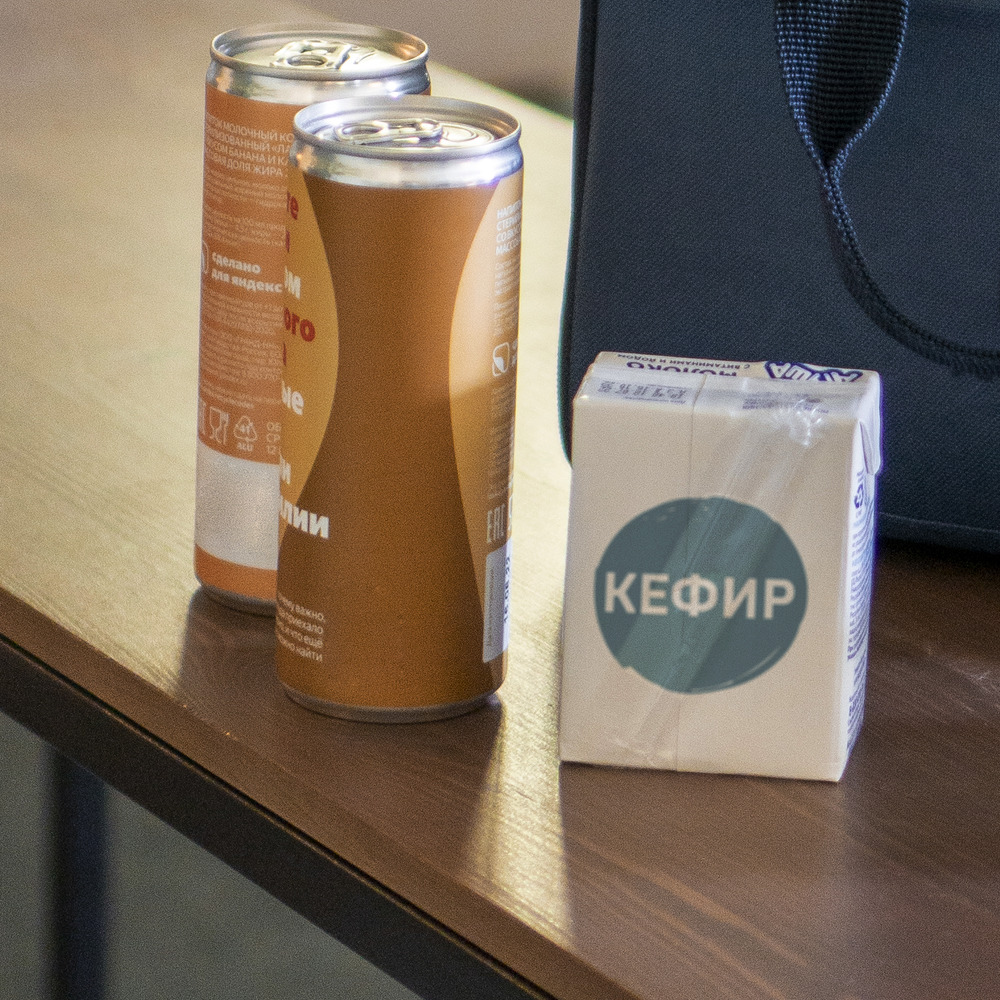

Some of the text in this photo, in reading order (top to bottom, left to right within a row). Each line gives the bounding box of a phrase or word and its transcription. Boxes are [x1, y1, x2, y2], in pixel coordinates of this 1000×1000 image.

[223, 121, 278, 140] МОЛОЧНЫЙ
[228, 148, 266, 163] БАНАНА
[268, 154, 277, 164] И
[227, 158, 250, 172] ДОЛЯ
[253, 165, 283, 178] ЖИРА
[212, 251, 262, 275] сделано
[212, 268, 283, 294] для яндекс
[617, 354, 657, 363] ЙОДОМ
[669, 359, 741, 370] ВИТАМИНАМИ
[604, 571, 796, 620] КЕФИР
